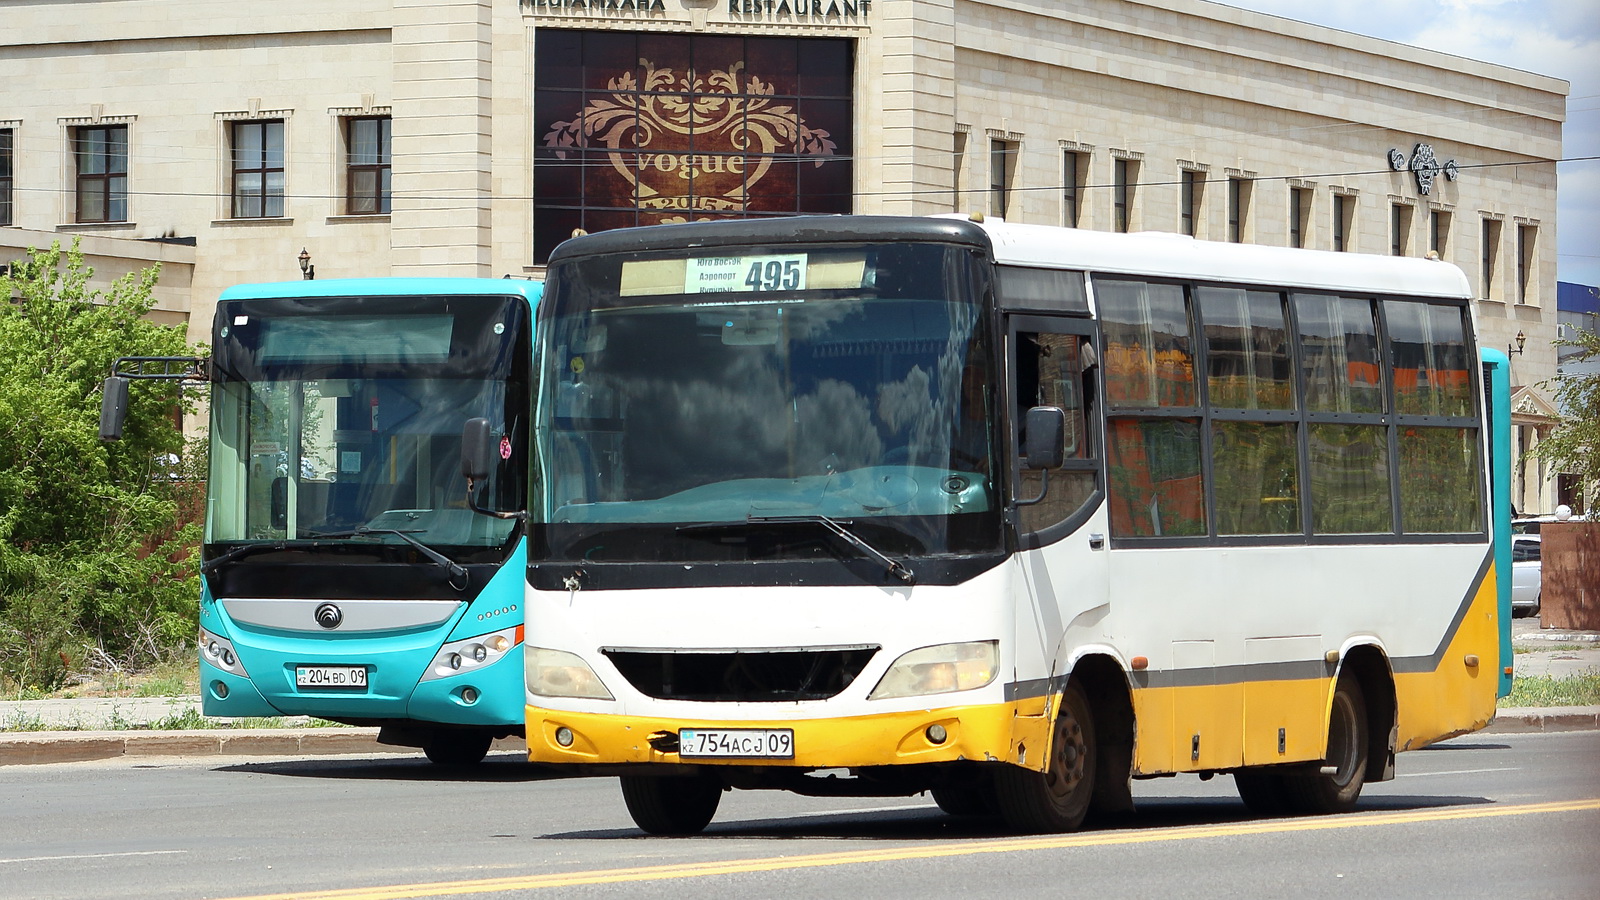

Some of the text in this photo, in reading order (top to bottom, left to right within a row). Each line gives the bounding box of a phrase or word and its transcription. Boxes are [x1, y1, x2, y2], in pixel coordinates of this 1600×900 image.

[729, 0, 871, 17] RESTAURANT
[632, 153, 744, 179] vogue
[661, 198, 717, 211] 2015
[699, 272, 736, 281] Аэропорт
[745, 260, 800, 291] 495
[309, 669, 364, 683] 204 BD 09
[768, 734, 790, 753] 09
